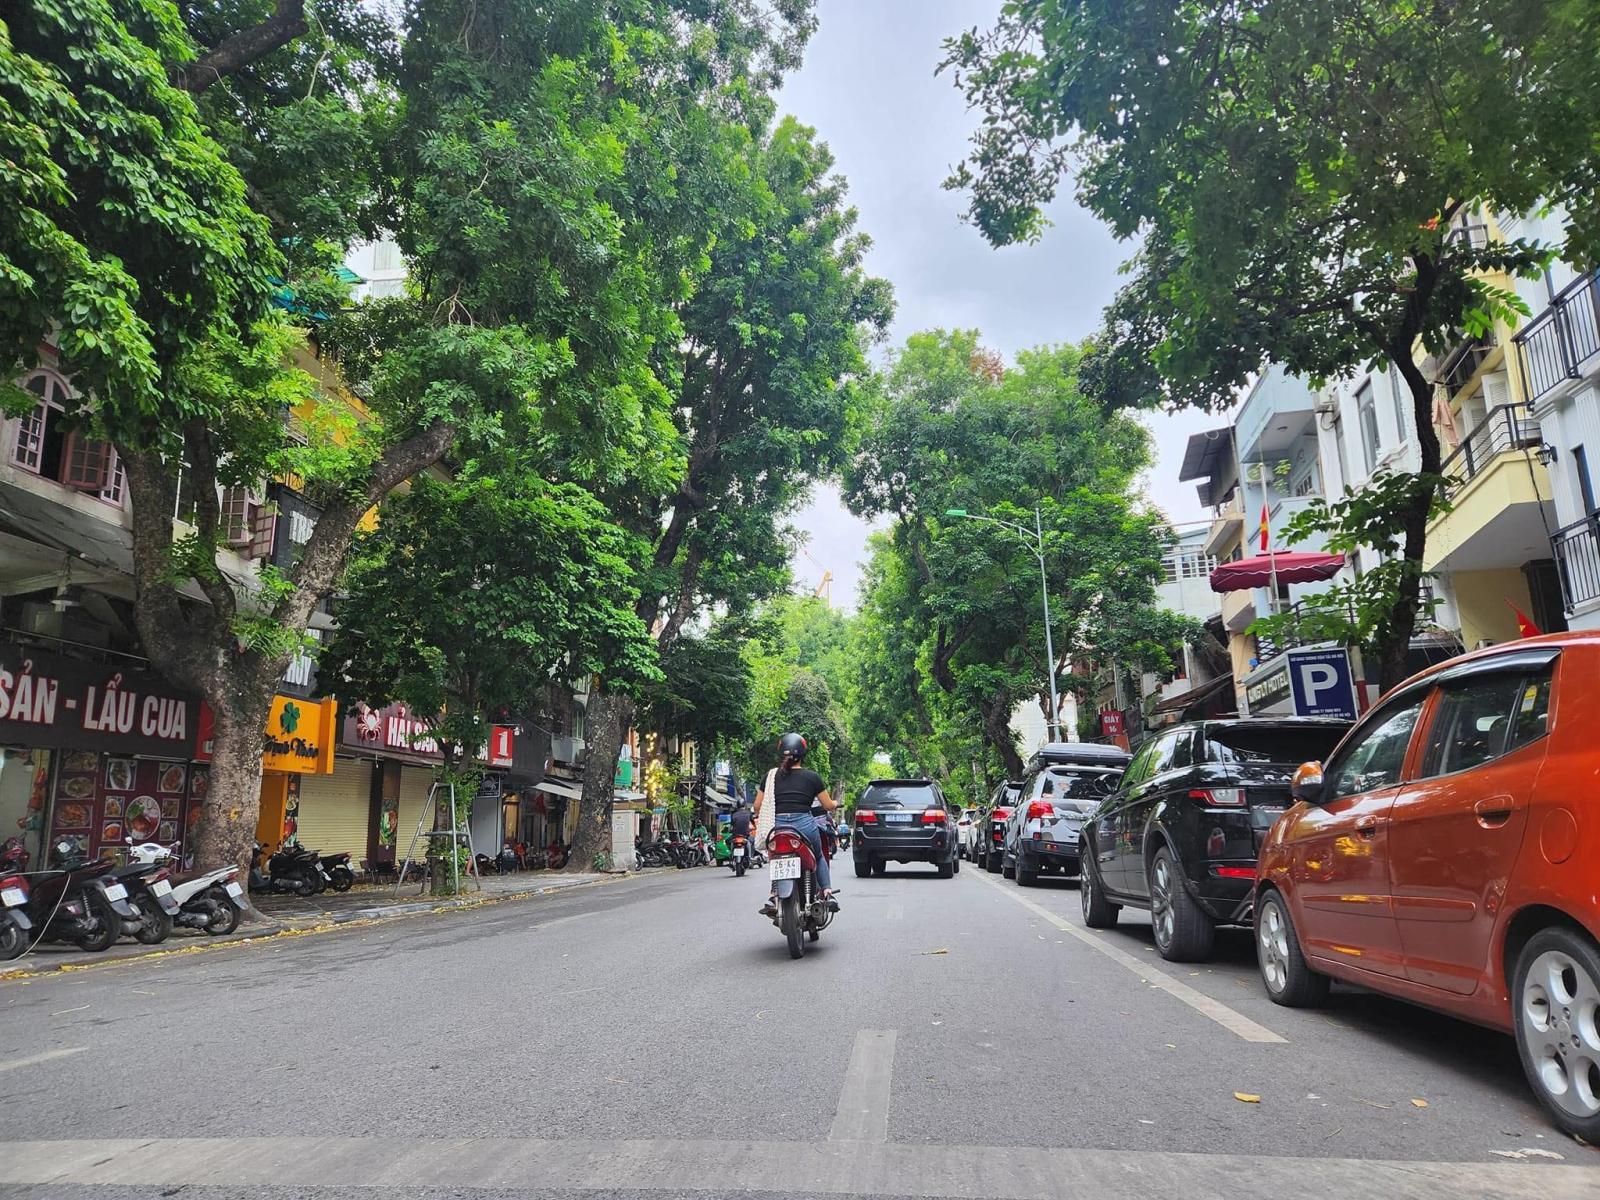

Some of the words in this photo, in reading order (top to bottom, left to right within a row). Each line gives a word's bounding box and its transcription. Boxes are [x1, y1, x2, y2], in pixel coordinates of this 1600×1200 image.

[0, 659, 59, 724] SẢN
[84, 672, 136, 734] LẨU
[141, 695, 186, 740] CUA
[1300, 663, 1339, 707] P
[387, 705, 411, 748] HẢI
[498, 731, 509, 757] 1
[1109, 725, 1117, 733] 16
